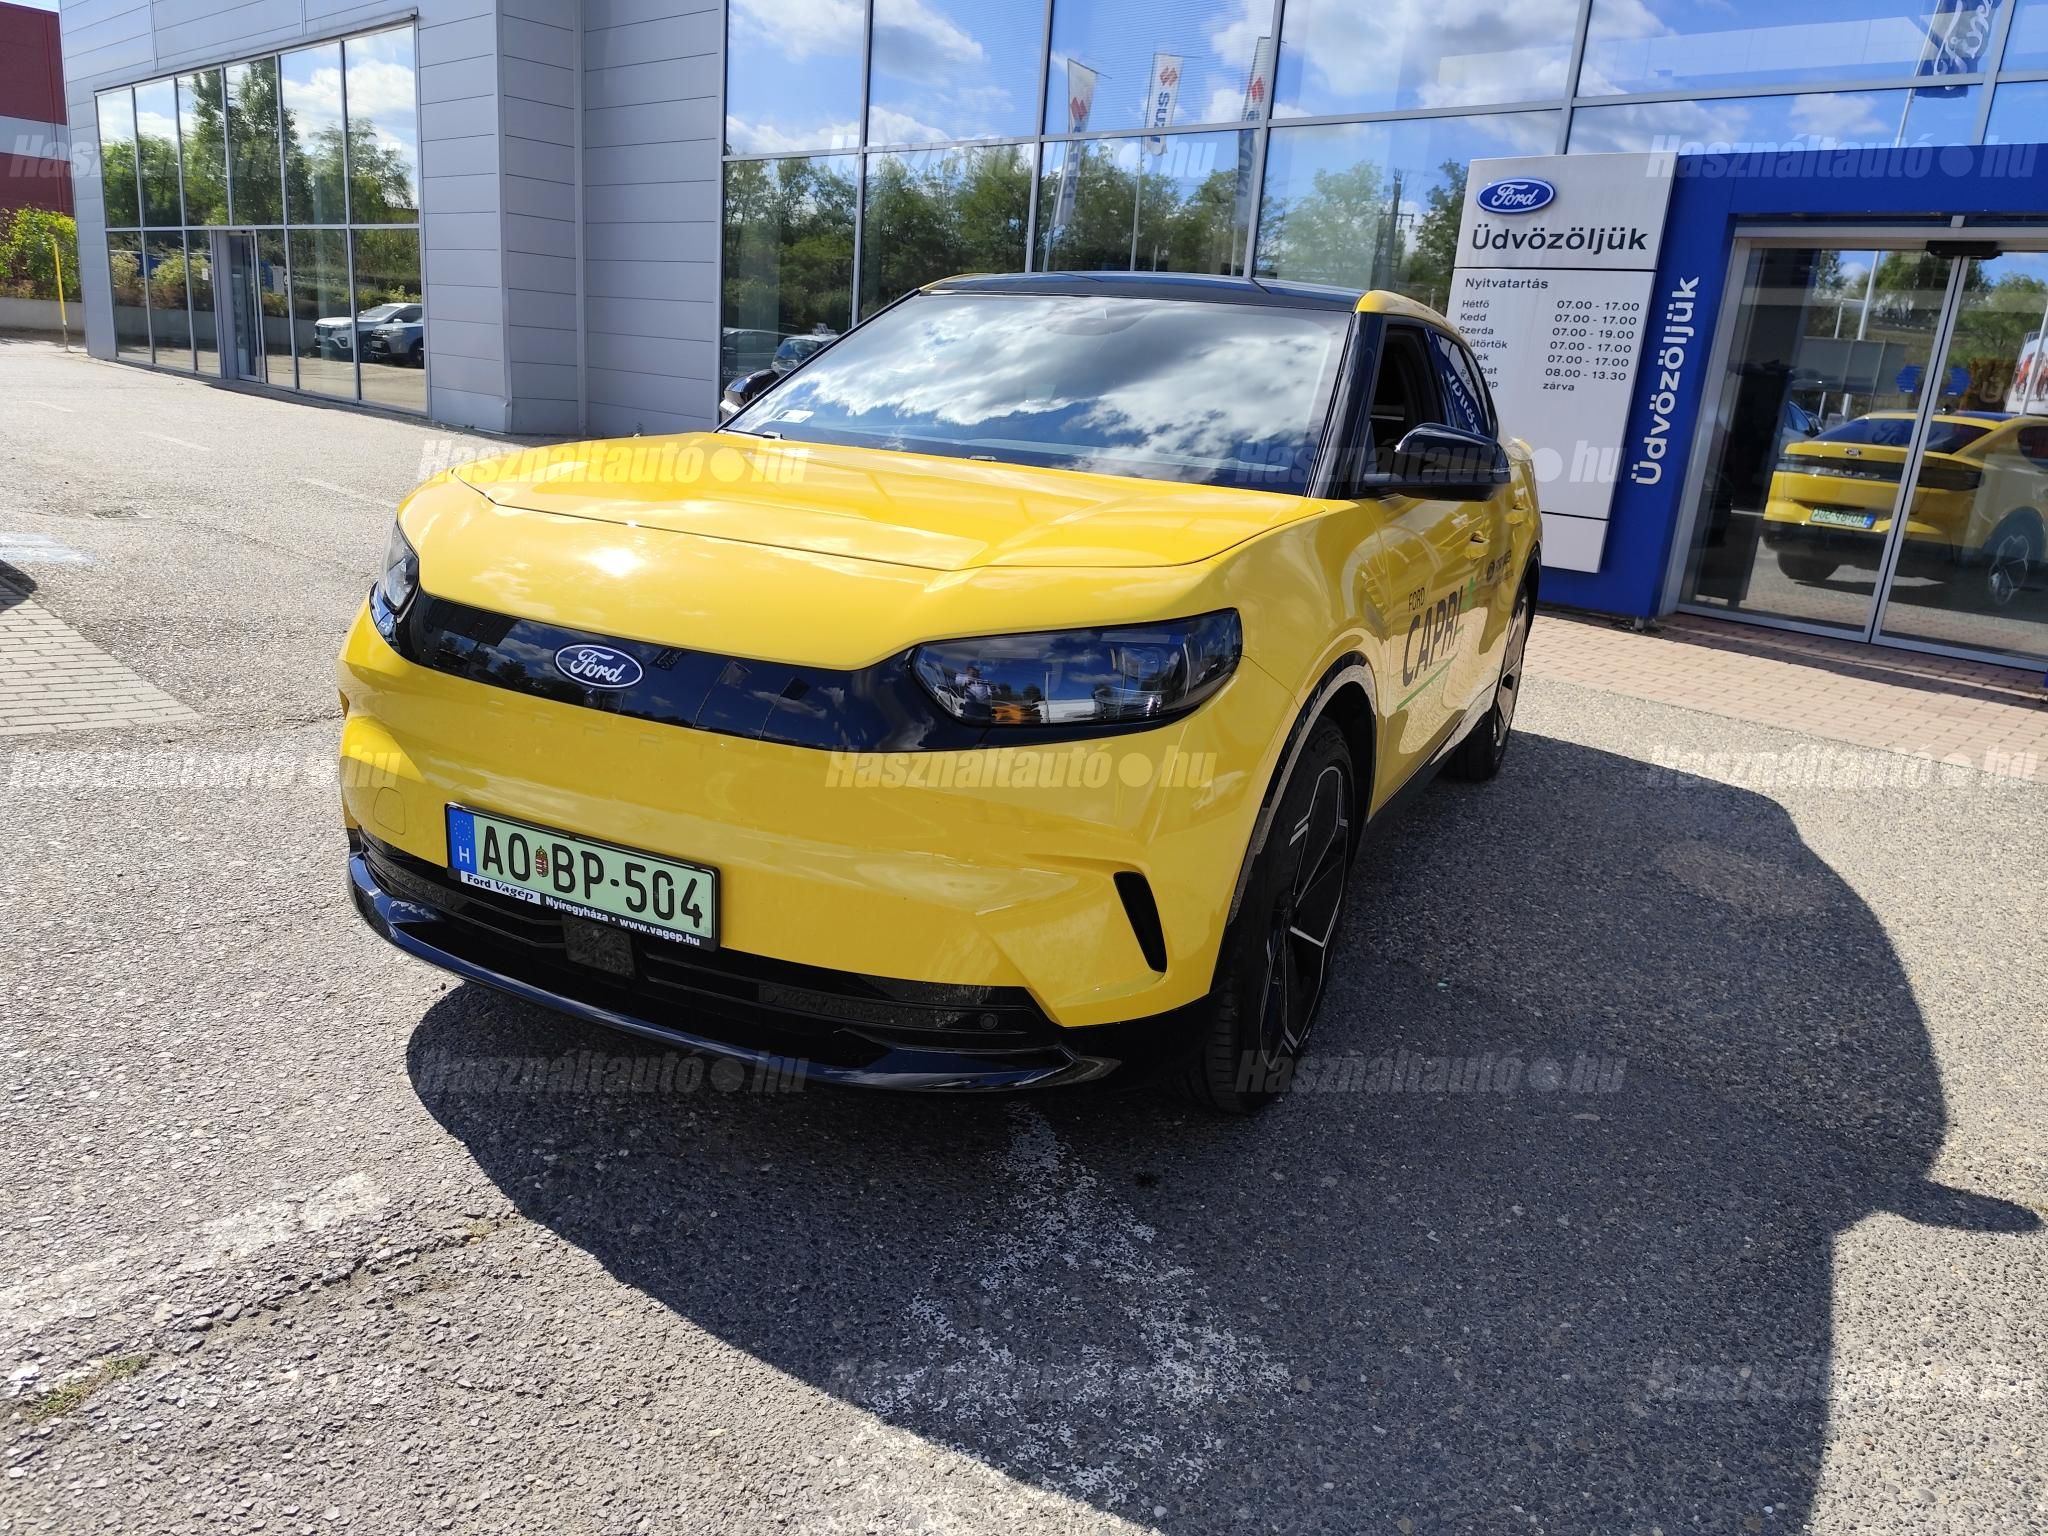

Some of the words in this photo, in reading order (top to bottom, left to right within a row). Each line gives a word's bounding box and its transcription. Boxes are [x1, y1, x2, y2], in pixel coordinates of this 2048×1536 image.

[1472, 224, 1649, 255] Üdvözöljük
[1465, 278, 1549, 290] Nyitvatartás
[1557, 300, 1592, 310] 07.00
[1605, 302, 1640, 311] 17.00
[1460, 313, 1487, 322] Kedd
[1554, 314, 1590, 323] 07.00
[1602, 316, 1637, 325] 17.00
[1458, 326, 1494, 336] Szerda
[1552, 327, 1587, 337] 07.00
[1599, 329, 1635, 339] 19.00
[1470, 340, 1508, 349] ütörtök
[1550, 341, 1585, 351] 07.00
[1597, 343, 1632, 353] 17.00
[1547, 354, 1582, 364] 07.00
[1595, 357, 1629, 367] 17.00
[1545, 368, 1581, 378] 08.00
[1592, 371, 1627, 381] 13.30
[1543, 382, 1575, 391] zárva
[1631, 277, 1699, 485] Üdvözöljük
[1408, 587, 1425, 612] FORD
[1402, 585, 1463, 687] CAPRI
[569, 649, 626, 682] Ford
[458, 846, 470, 865] H
[482, 825, 531, 882] AO
[551, 843, 703, 929] BP-504
[466, 873, 491, 889] Ford
[545, 895, 609, 923] Nyíregyháza
[619, 916, 700, 946] www.vagep.hu
